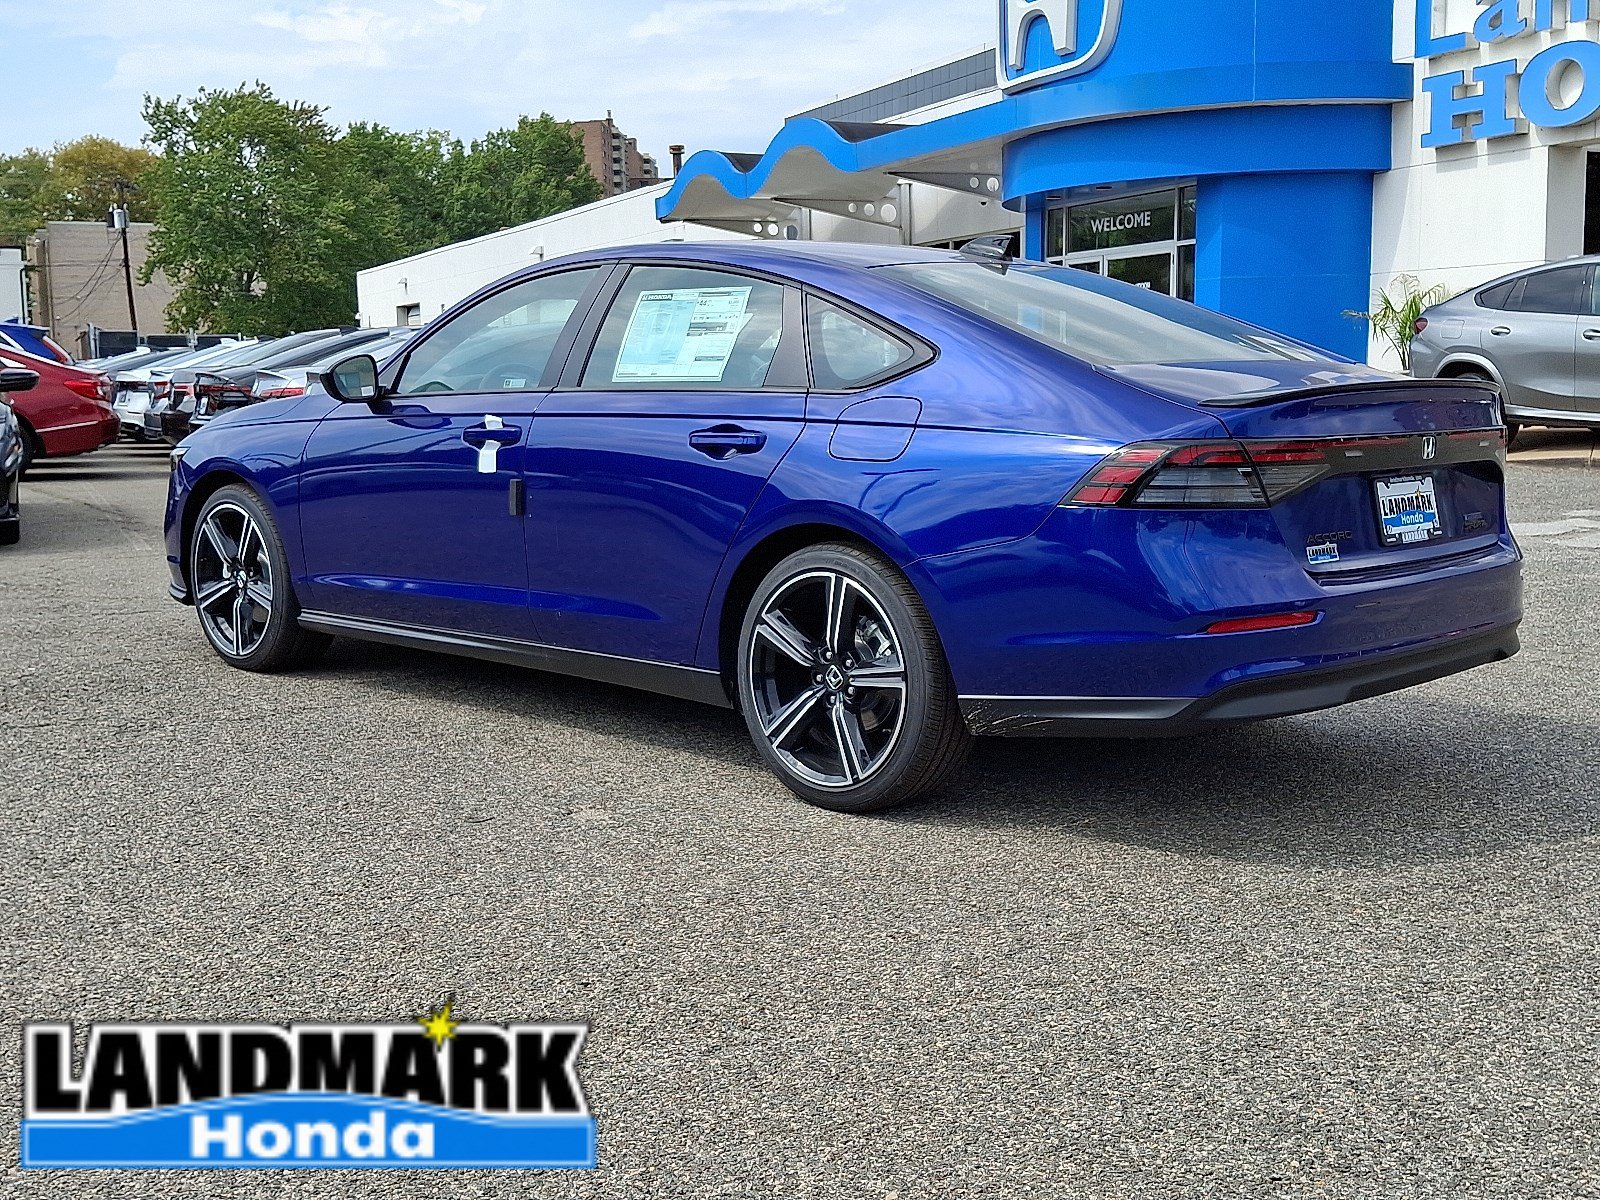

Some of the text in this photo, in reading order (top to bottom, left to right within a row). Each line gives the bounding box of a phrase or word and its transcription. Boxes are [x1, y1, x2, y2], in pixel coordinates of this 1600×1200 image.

[1090, 211, 1151, 233] WELCOME
[1381, 493, 1434, 517] LANDMARK
[1400, 512, 1424, 525] Honda
[1307, 531, 1352, 543] ACCORD
